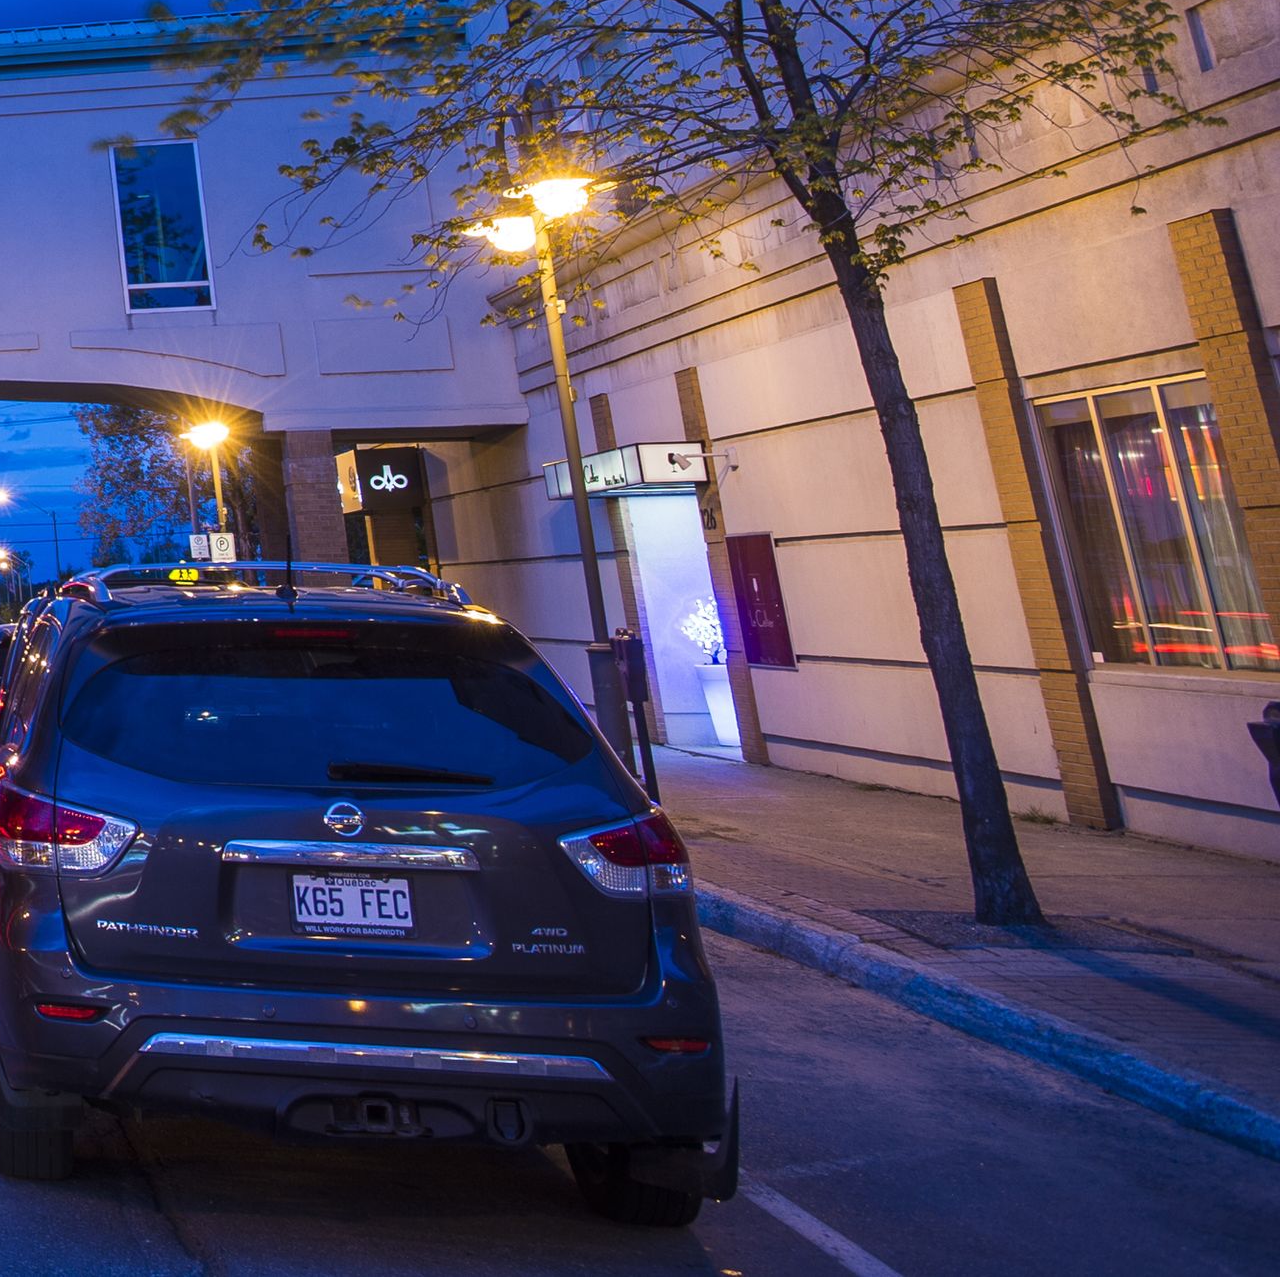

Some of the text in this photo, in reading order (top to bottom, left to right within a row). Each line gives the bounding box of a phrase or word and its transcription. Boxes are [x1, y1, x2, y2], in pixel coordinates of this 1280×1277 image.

[295, 885, 409, 920] K65 FEC
[96, 919, 199, 939] PATHFINDER
[304, 925, 406, 936] WILL WORK FOR BANDWIDTH
[531, 926, 569, 937] 4WD
[512, 942, 587, 954] PLATINUM
